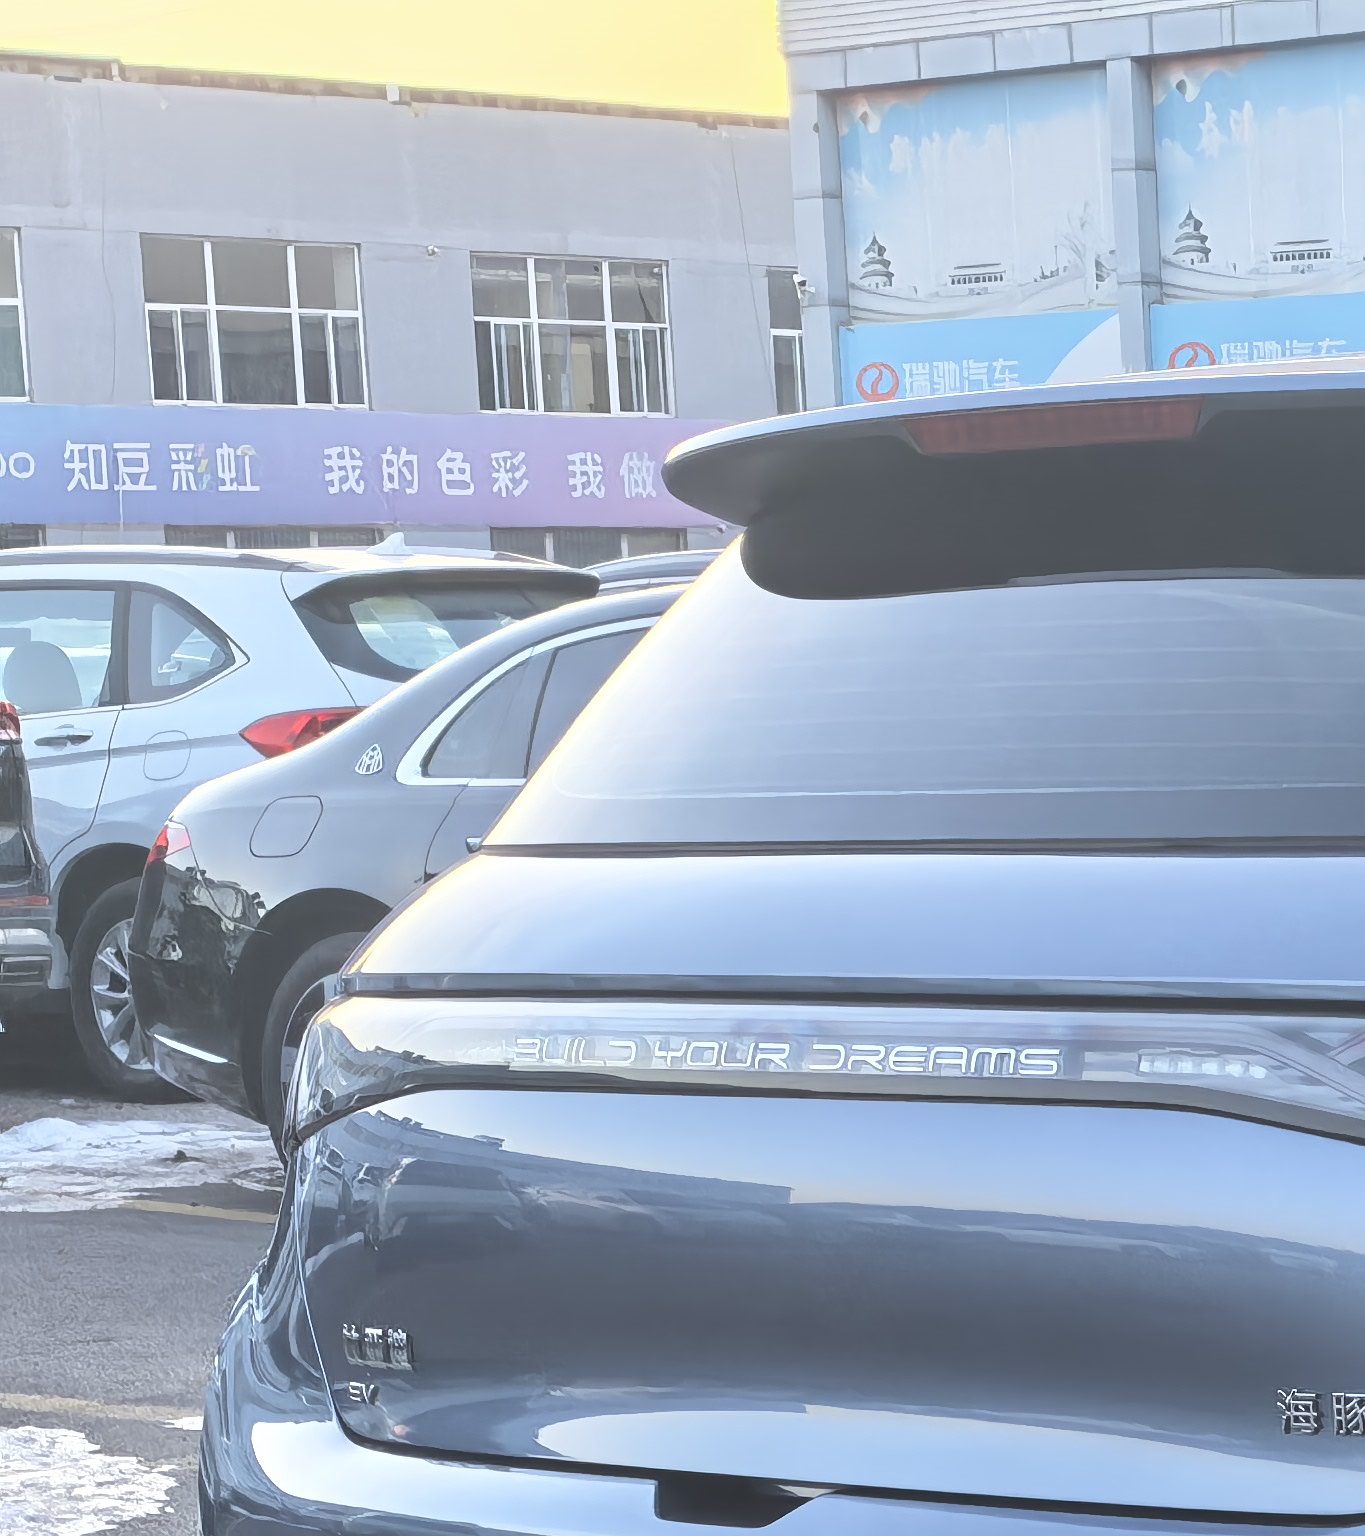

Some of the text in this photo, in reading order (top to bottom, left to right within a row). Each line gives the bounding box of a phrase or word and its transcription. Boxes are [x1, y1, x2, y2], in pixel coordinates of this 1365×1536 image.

[63, 440, 260, 492] 知豆彩虹
[323, 446, 529, 498] 我的色彩
[567, 451, 657, 498] 我做
[513, 1037, 1061, 1075] BUILD YOUR DREAMS
